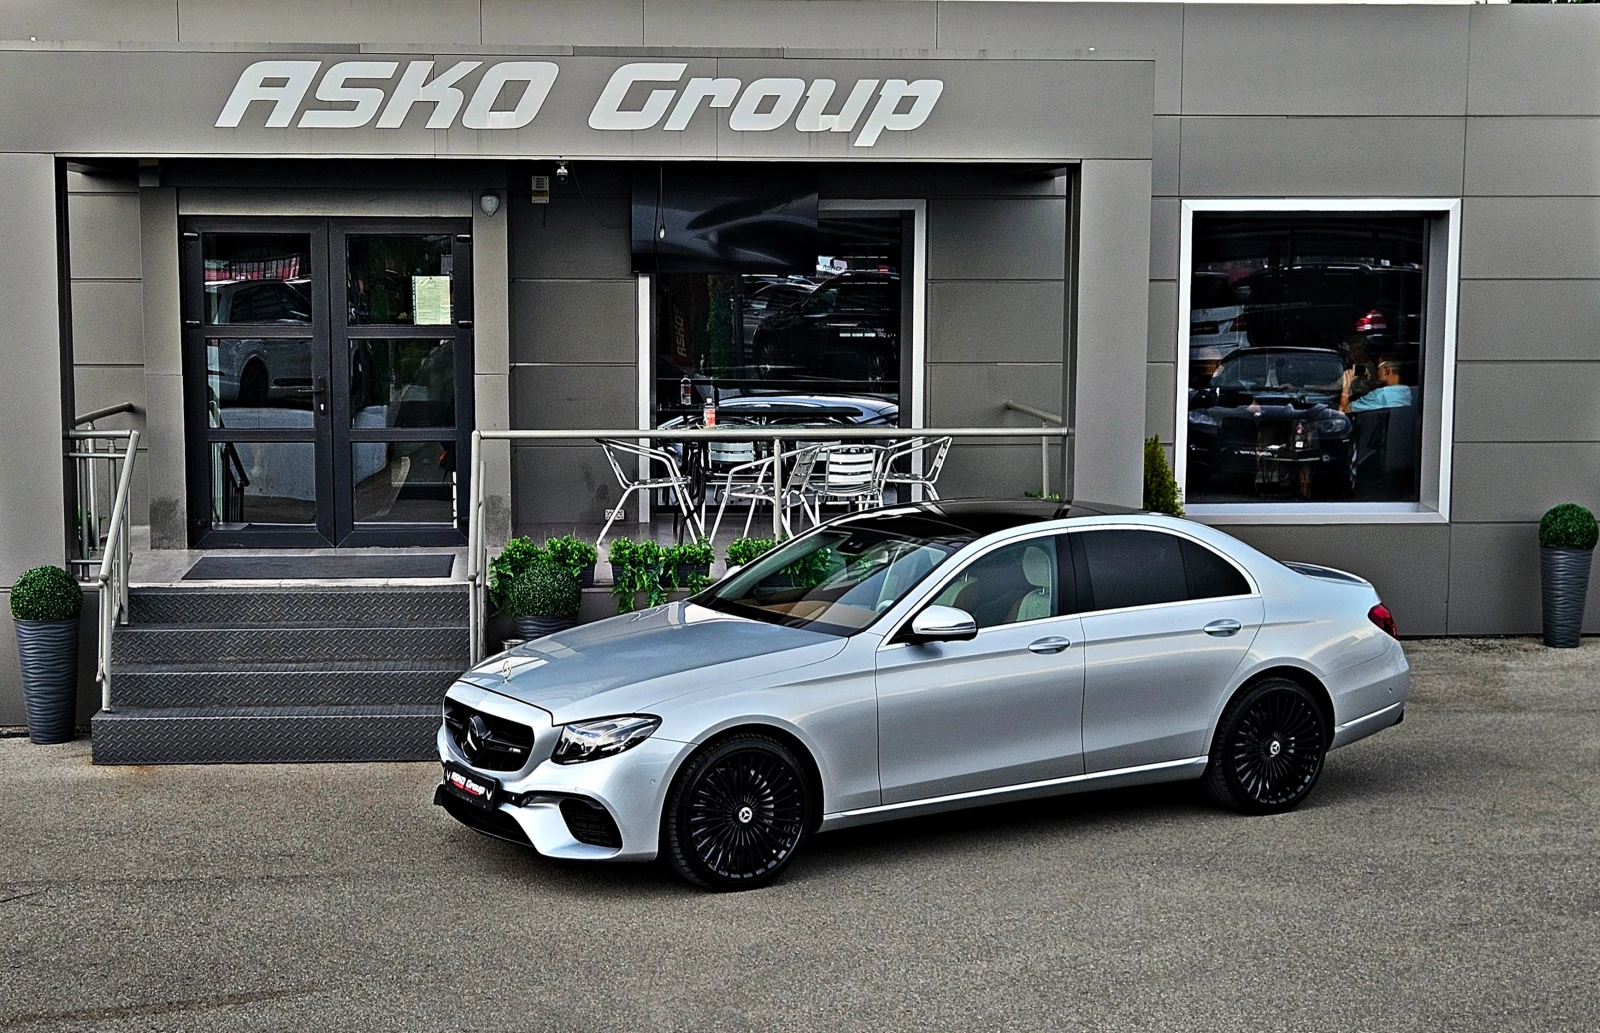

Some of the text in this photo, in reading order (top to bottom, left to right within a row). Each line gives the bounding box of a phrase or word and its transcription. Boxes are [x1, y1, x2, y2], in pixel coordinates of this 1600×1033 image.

[215, 60, 944, 147] ASKO Group
[466, 779, 486, 796] Group
